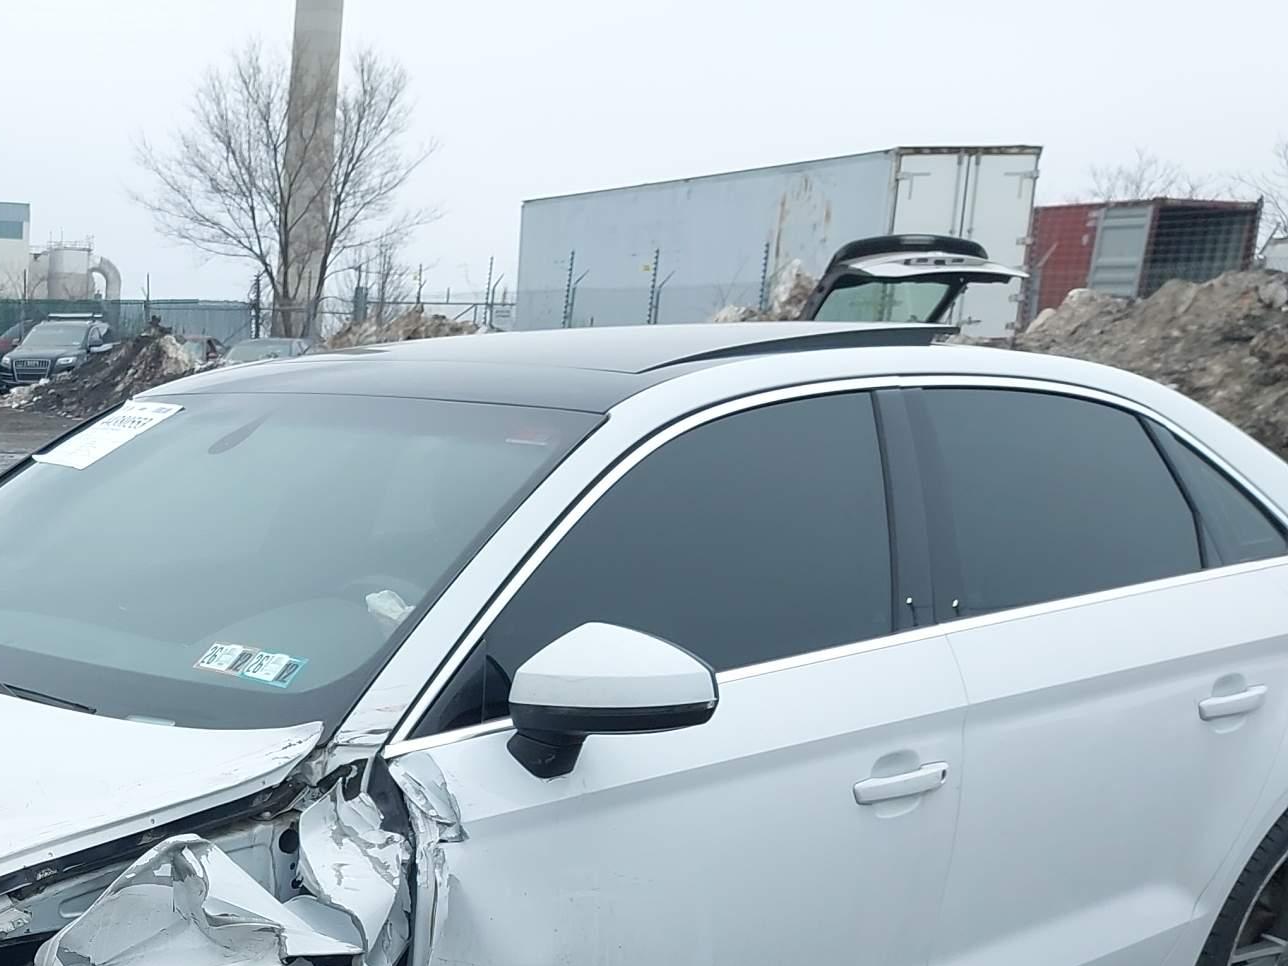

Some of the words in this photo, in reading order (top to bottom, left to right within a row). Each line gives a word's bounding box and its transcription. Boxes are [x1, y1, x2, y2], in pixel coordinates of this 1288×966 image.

[201, 645, 224, 664] 26
[228, 652, 253, 672] 12
[246, 654, 270, 674] 26
[274, 662, 300, 683] 12
